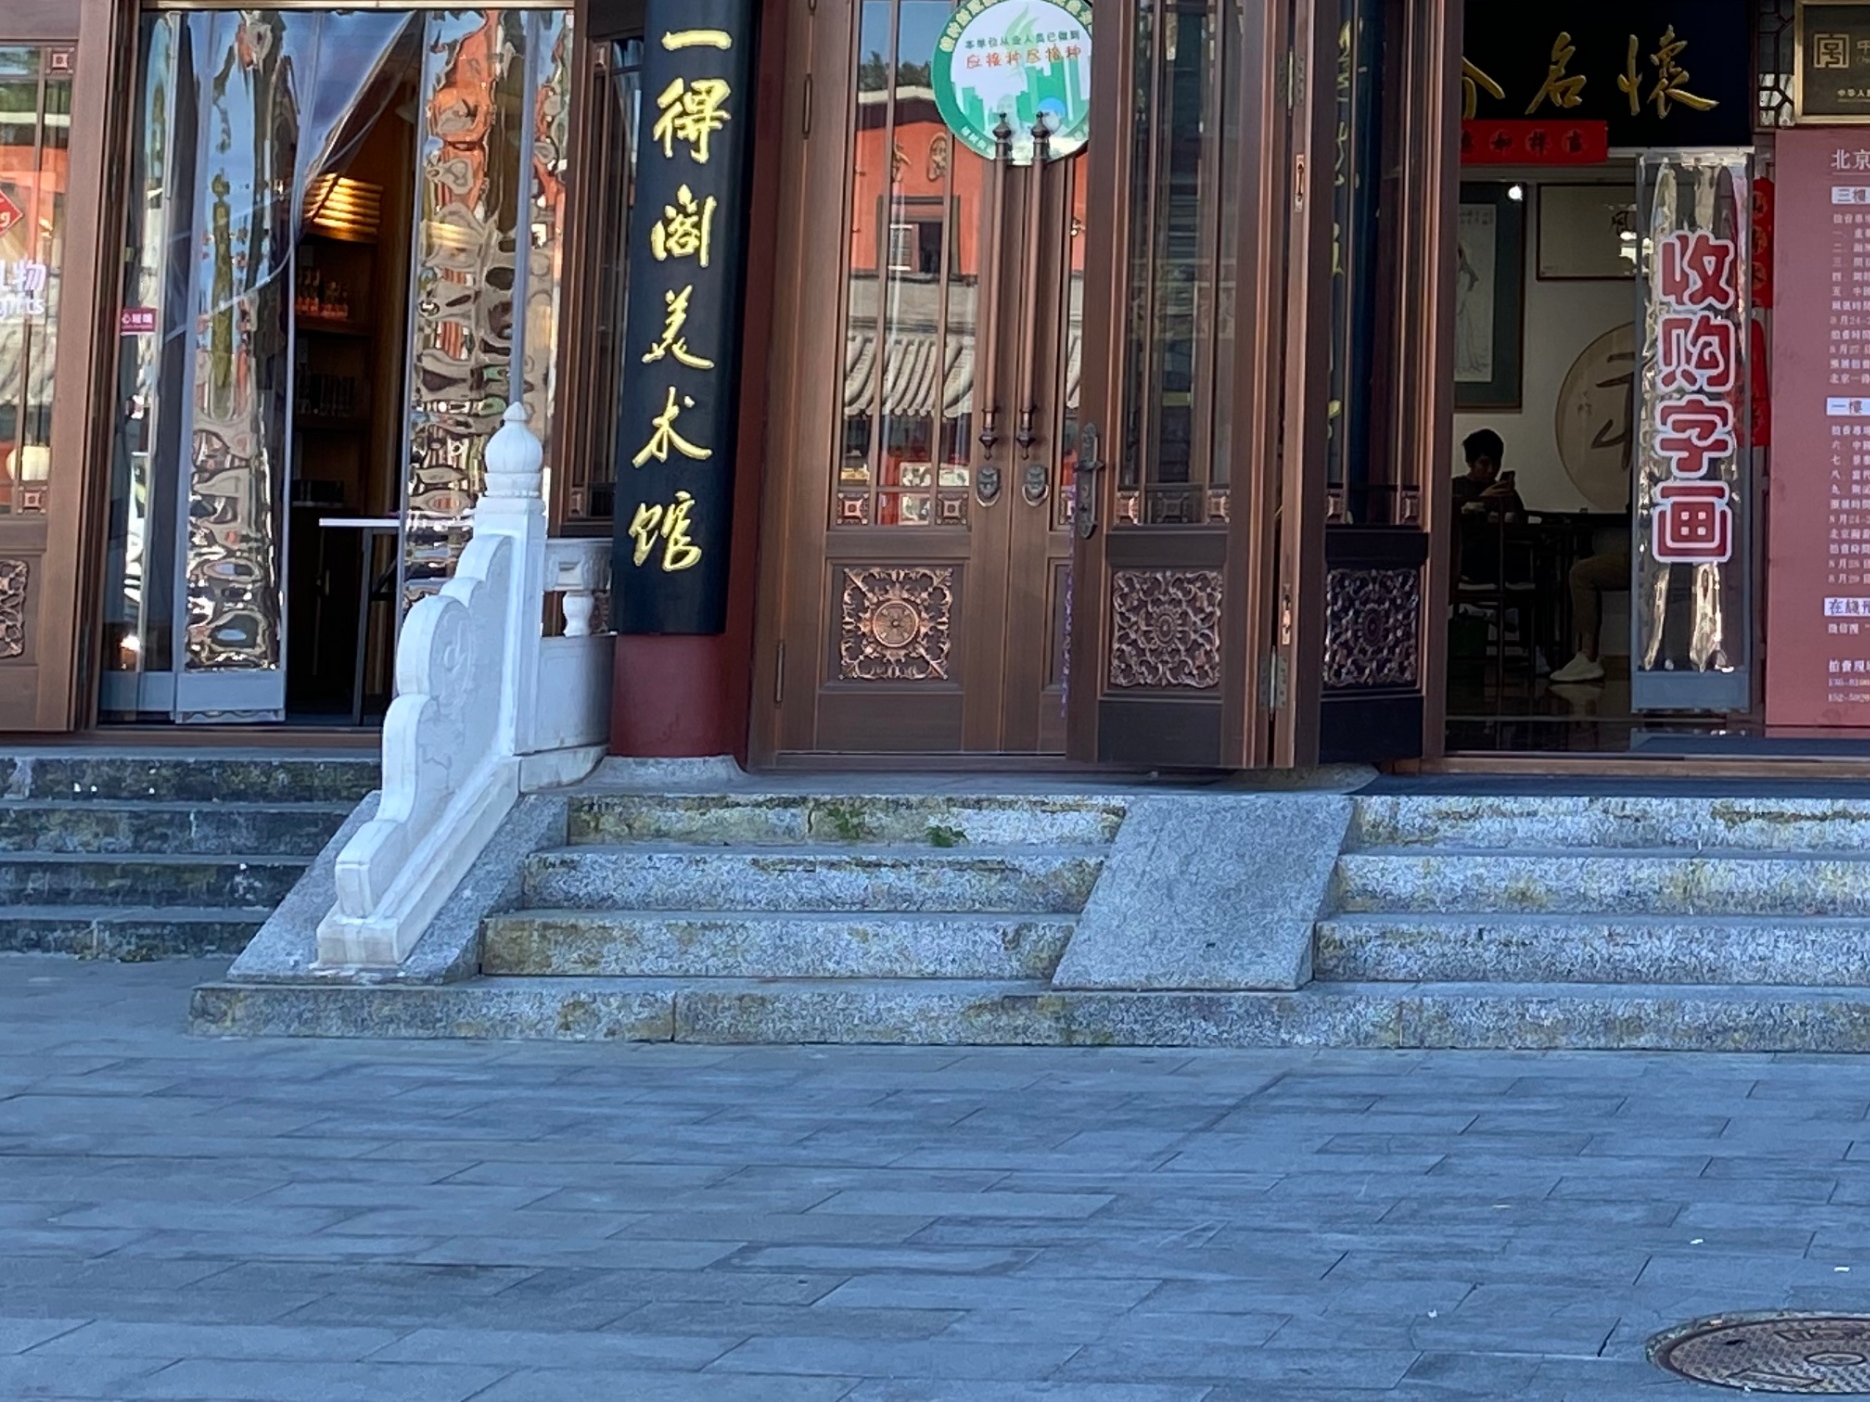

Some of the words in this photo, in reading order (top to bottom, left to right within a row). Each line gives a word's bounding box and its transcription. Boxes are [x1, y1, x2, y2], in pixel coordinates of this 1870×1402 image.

[965, 30, 1080, 49] 本单位从业人员已做到
[966, 44, 1082, 69] 应接种尽接种
[1652, 228, 1735, 564] 收购字画
